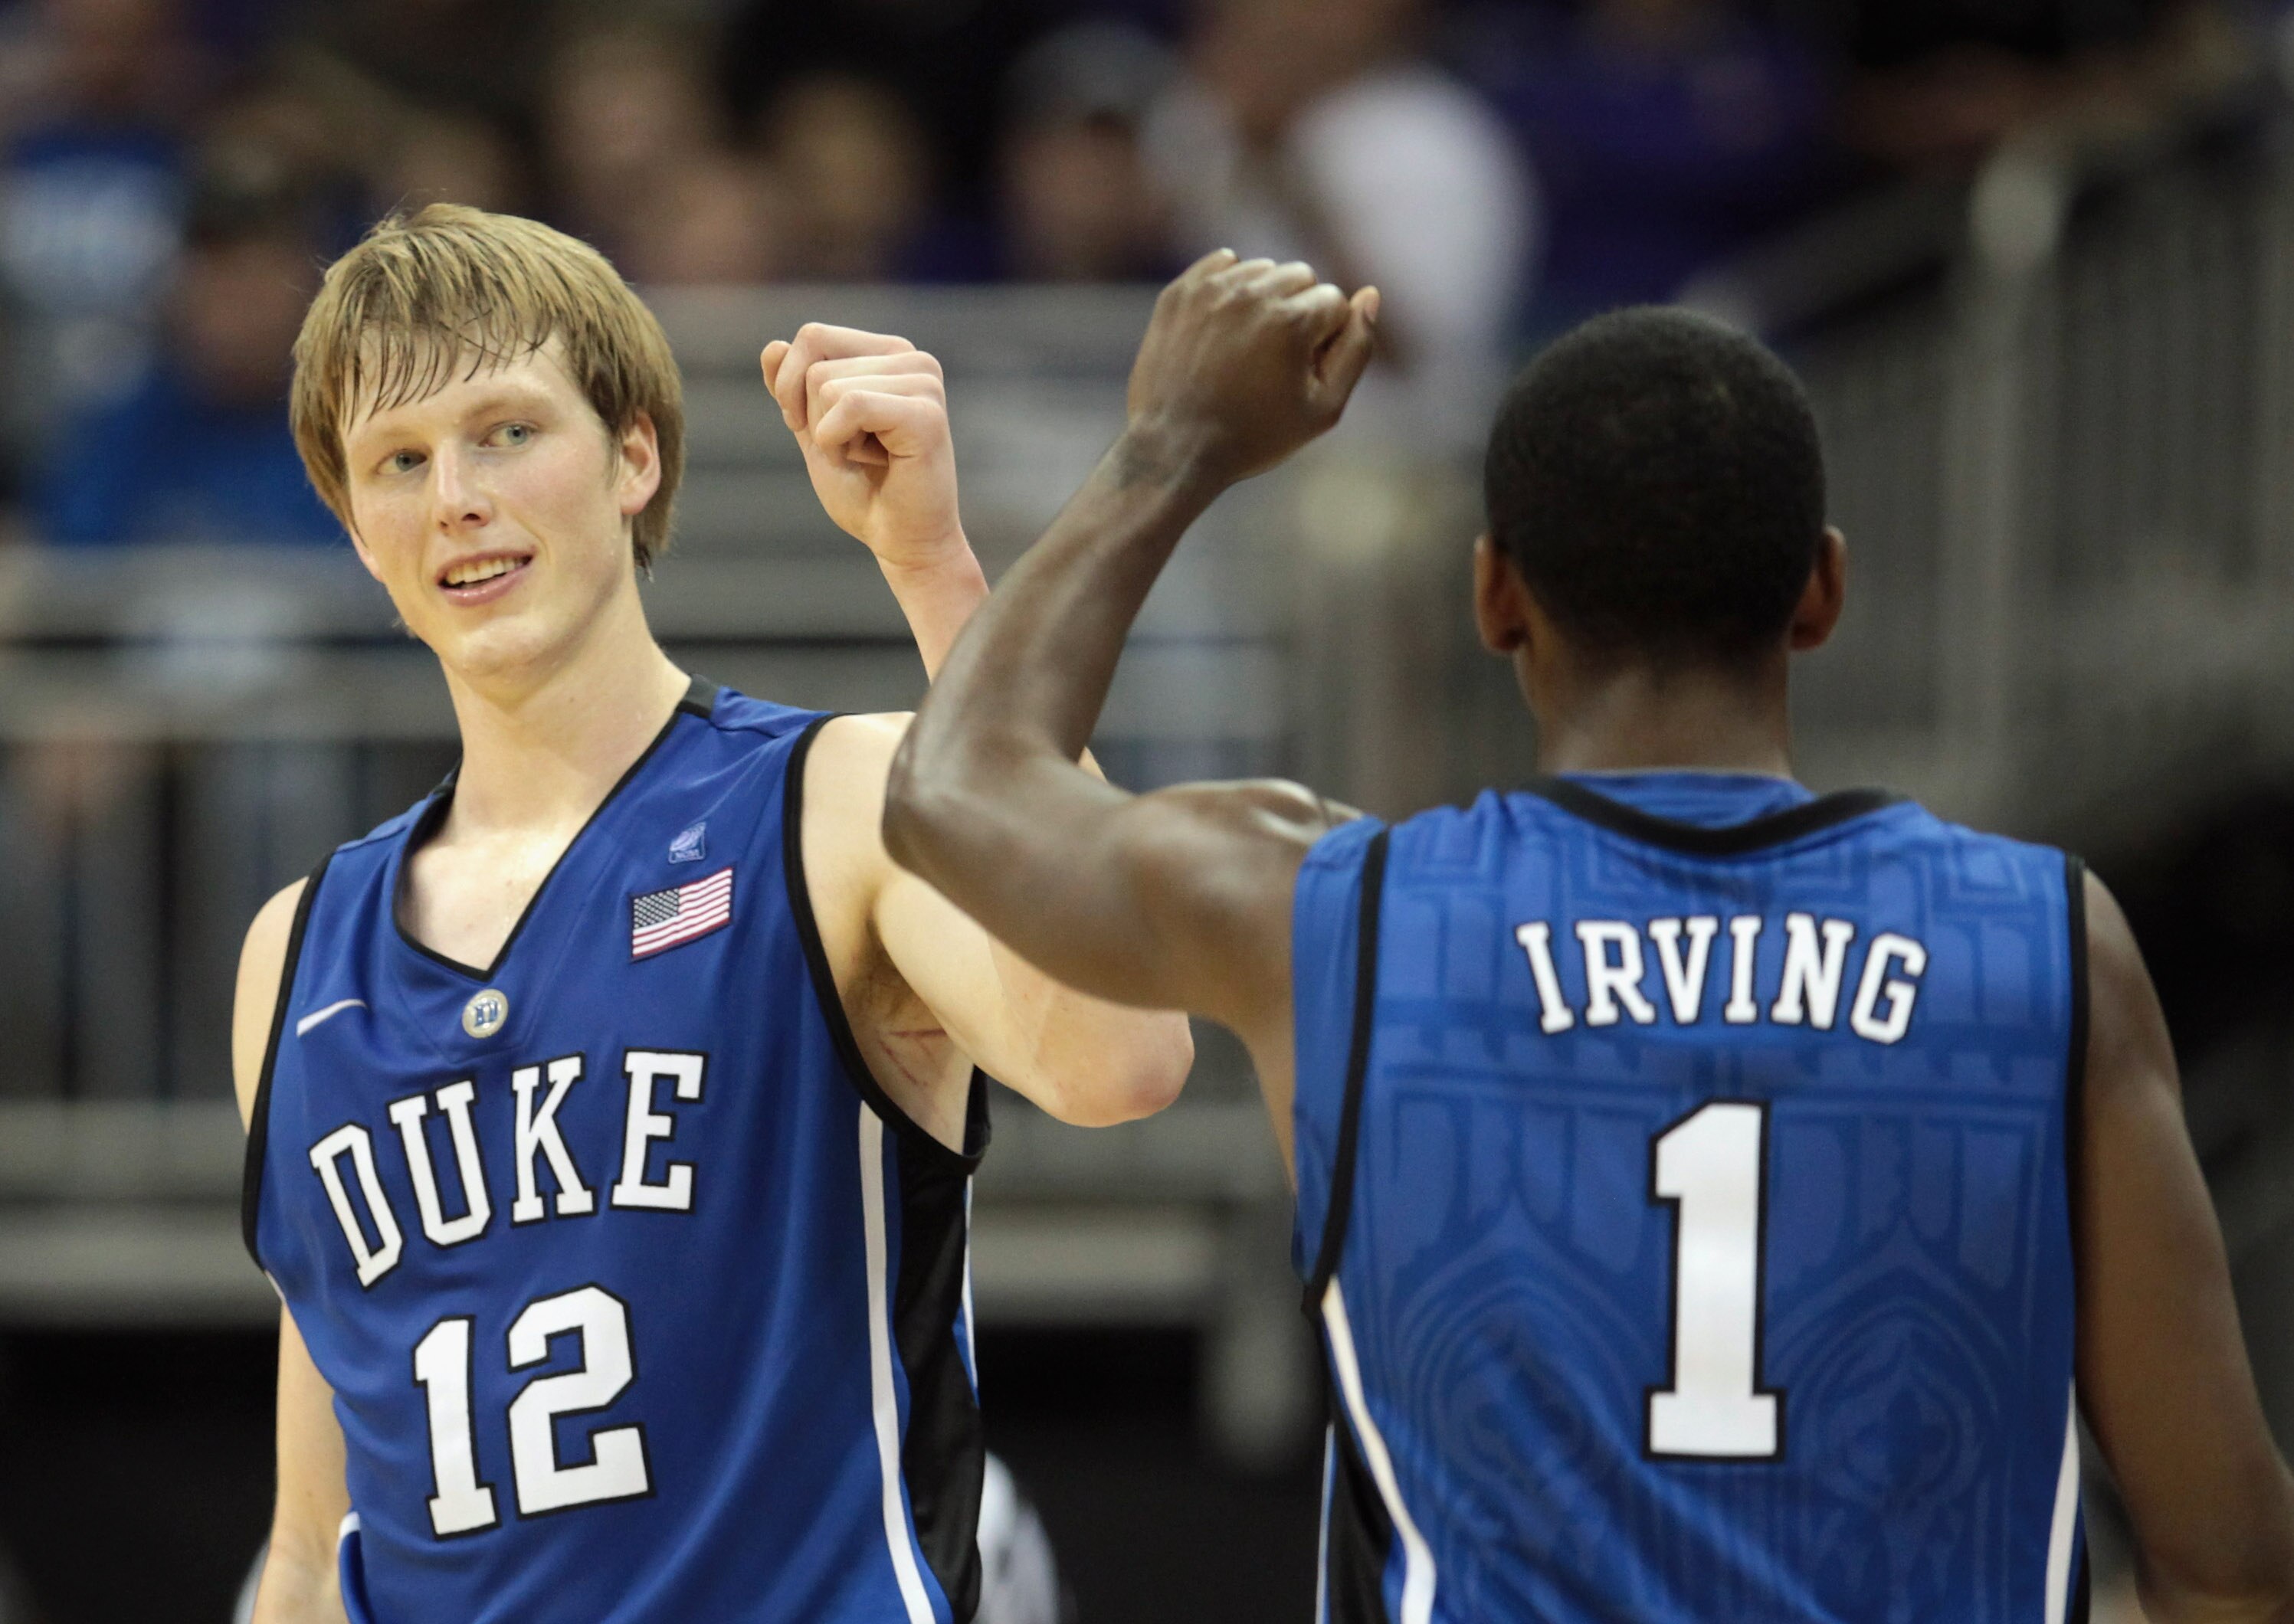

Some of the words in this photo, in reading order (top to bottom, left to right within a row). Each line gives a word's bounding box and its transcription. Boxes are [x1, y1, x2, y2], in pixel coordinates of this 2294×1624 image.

[1515, 912, 1928, 1045] IRVING
[307, 1049, 706, 1290] DUKE
[1647, 1100, 1784, 1459] 1
[412, 1284, 654, 1538] 12
